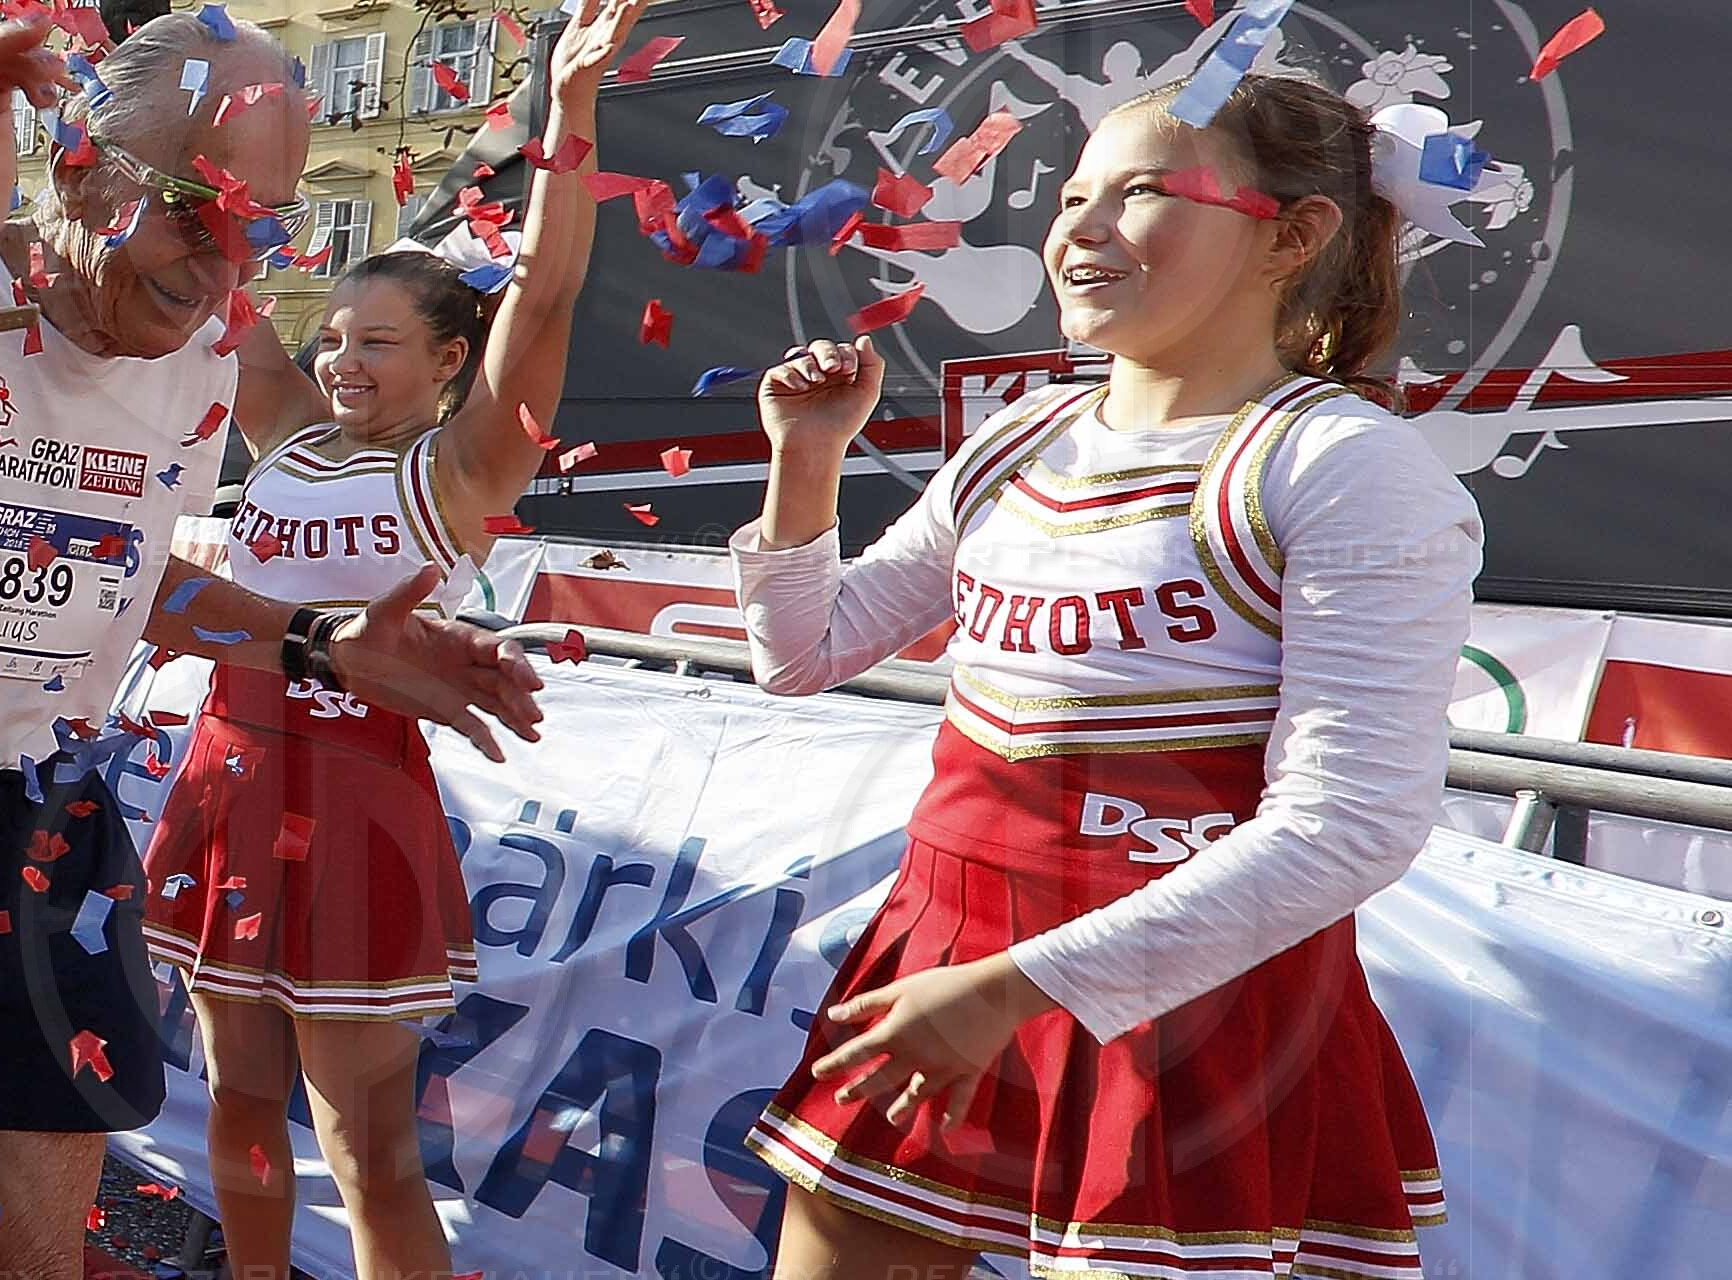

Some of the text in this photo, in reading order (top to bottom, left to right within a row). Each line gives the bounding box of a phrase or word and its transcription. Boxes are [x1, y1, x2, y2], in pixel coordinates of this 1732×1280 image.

[31, 438, 81, 466] GRAZ
[85, 451, 146, 476] KLEINE
[81, 472, 142, 495] ZEITUNG
[954, 569, 1218, 657] EDHOTS
